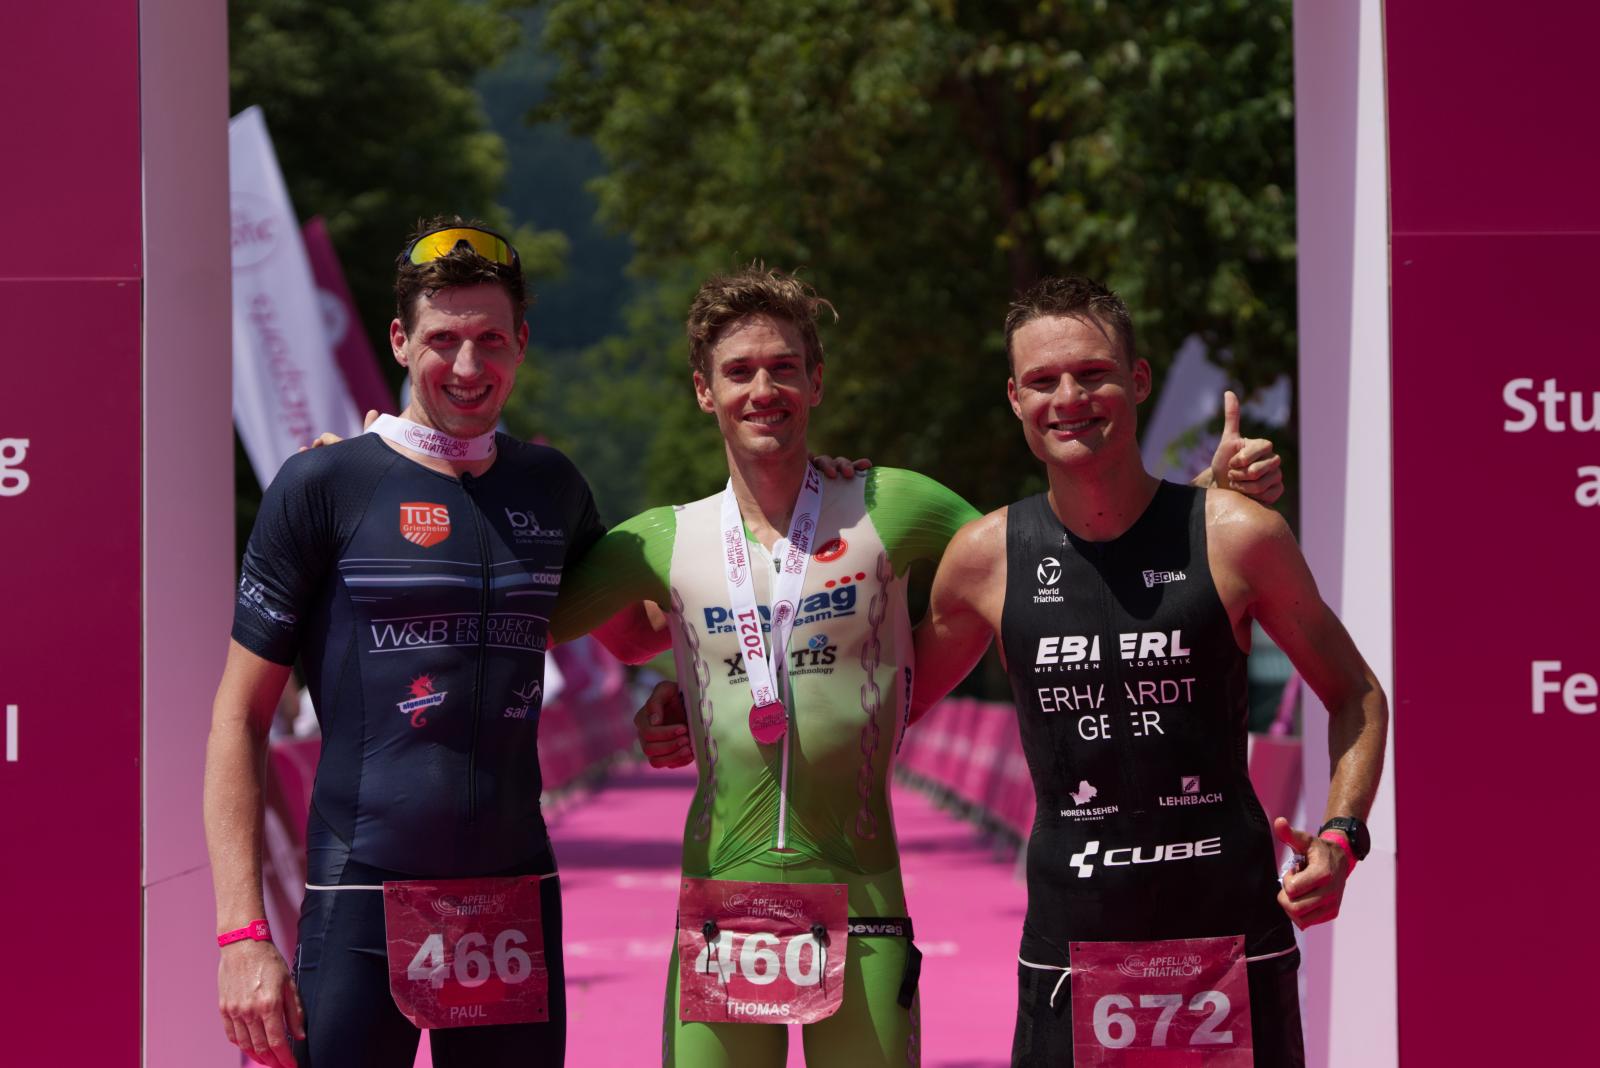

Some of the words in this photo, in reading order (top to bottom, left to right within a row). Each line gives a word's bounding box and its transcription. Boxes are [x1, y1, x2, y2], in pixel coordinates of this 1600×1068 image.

[1502, 378, 1600, 432] Stu
[418, 439, 467, 457] TRIATHLON
[400, 506, 450, 525] TuS
[403, 524, 448, 532] Griesheim
[732, 525, 746, 568] TRIATHLON
[785, 529, 802, 574] TRIATHLON
[1038, 587, 1060, 596] World
[371, 619, 449, 648] W&B
[456, 617, 534, 633] PROJEKT
[738, 609, 763, 660] 2021
[1060, 663, 1100, 672] LEBEN
[1129, 657, 1191, 668] LOGISTIK
[1531, 660, 1599, 714] Fe
[1159, 792, 1223, 806] LEHRBACH
[1092, 804, 1119, 816] SEHEN
[1103, 836, 1222, 867] CUBE
[752, 898, 804, 907] APFELLAND
[747, 906, 805, 918] TRIATHLON
[407, 928, 532, 989] 466
[694, 929, 827, 986] 460
[1149, 954, 1202, 966] APFELLAND
[1142, 965, 1203, 978] TRIATHLON
[450, 1004, 488, 1019] PAUL
[726, 1001, 790, 1017] THOMAS
[1092, 990, 1234, 1050] 672
